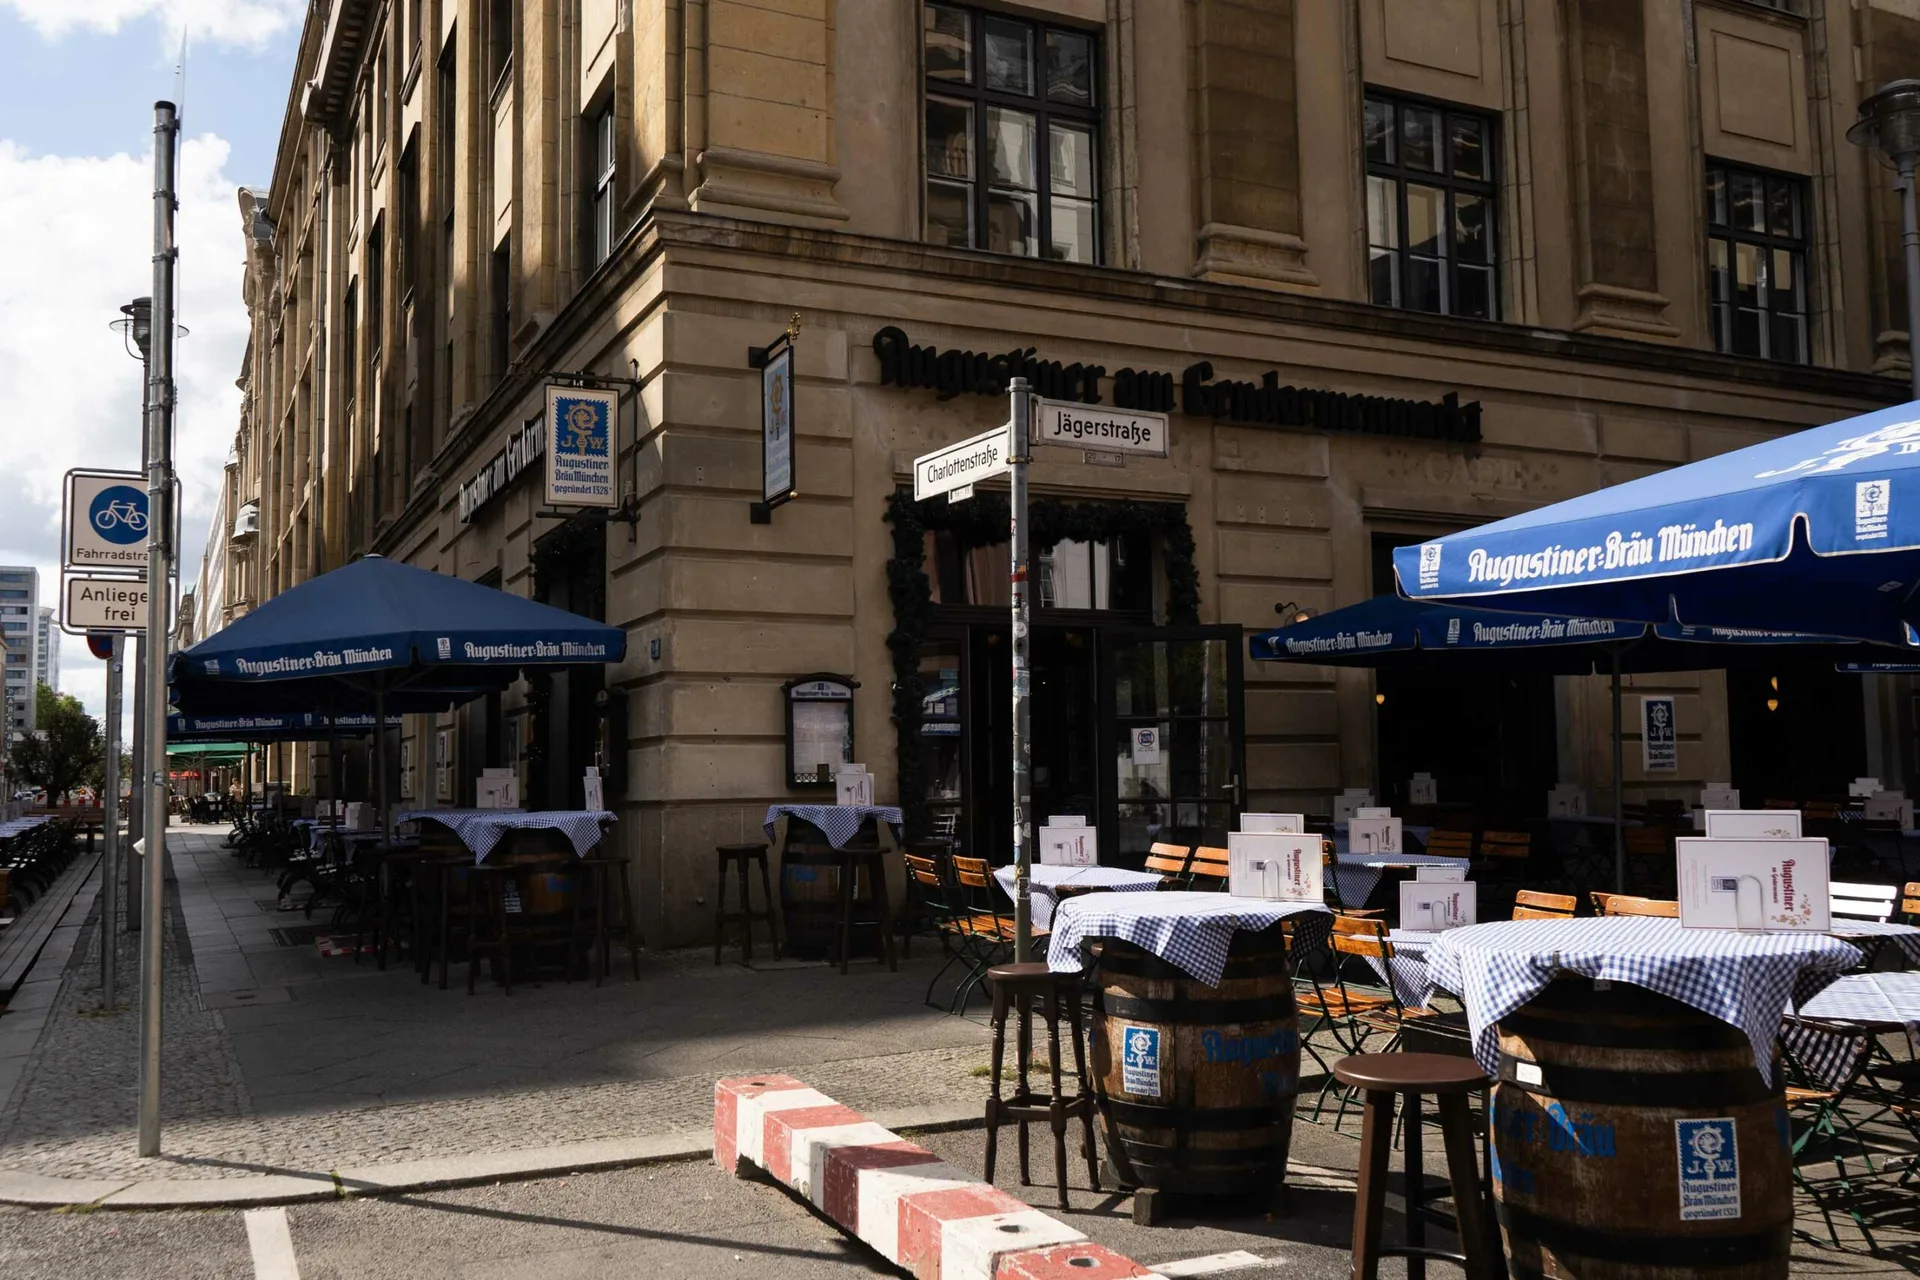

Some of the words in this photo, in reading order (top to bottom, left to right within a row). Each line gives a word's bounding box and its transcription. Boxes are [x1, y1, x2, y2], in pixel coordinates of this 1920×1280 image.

[873, 325, 1106, 404] Augustiner
[1113, 367, 1177, 412] am
[1183, 360, 1482, 442] Gendarmenmarkt
[1053, 410, 1151, 446] Jägerstraße
[926, 443, 998, 484] Charlottenstraße
[554, 469, 574, 482] Bräu
[574, 470, 609, 483] München
[554, 484, 592, 496] gegründet
[1656, 518, 1753, 562] München
[76, 548, 149, 561] Fahrradstra
[80, 587, 148, 606] Anliege
[104, 606, 135, 621] frei
[344, 646, 393, 664] München
[561, 641, 606, 657] München
[1780, 858, 1797, 912] Augustiner
